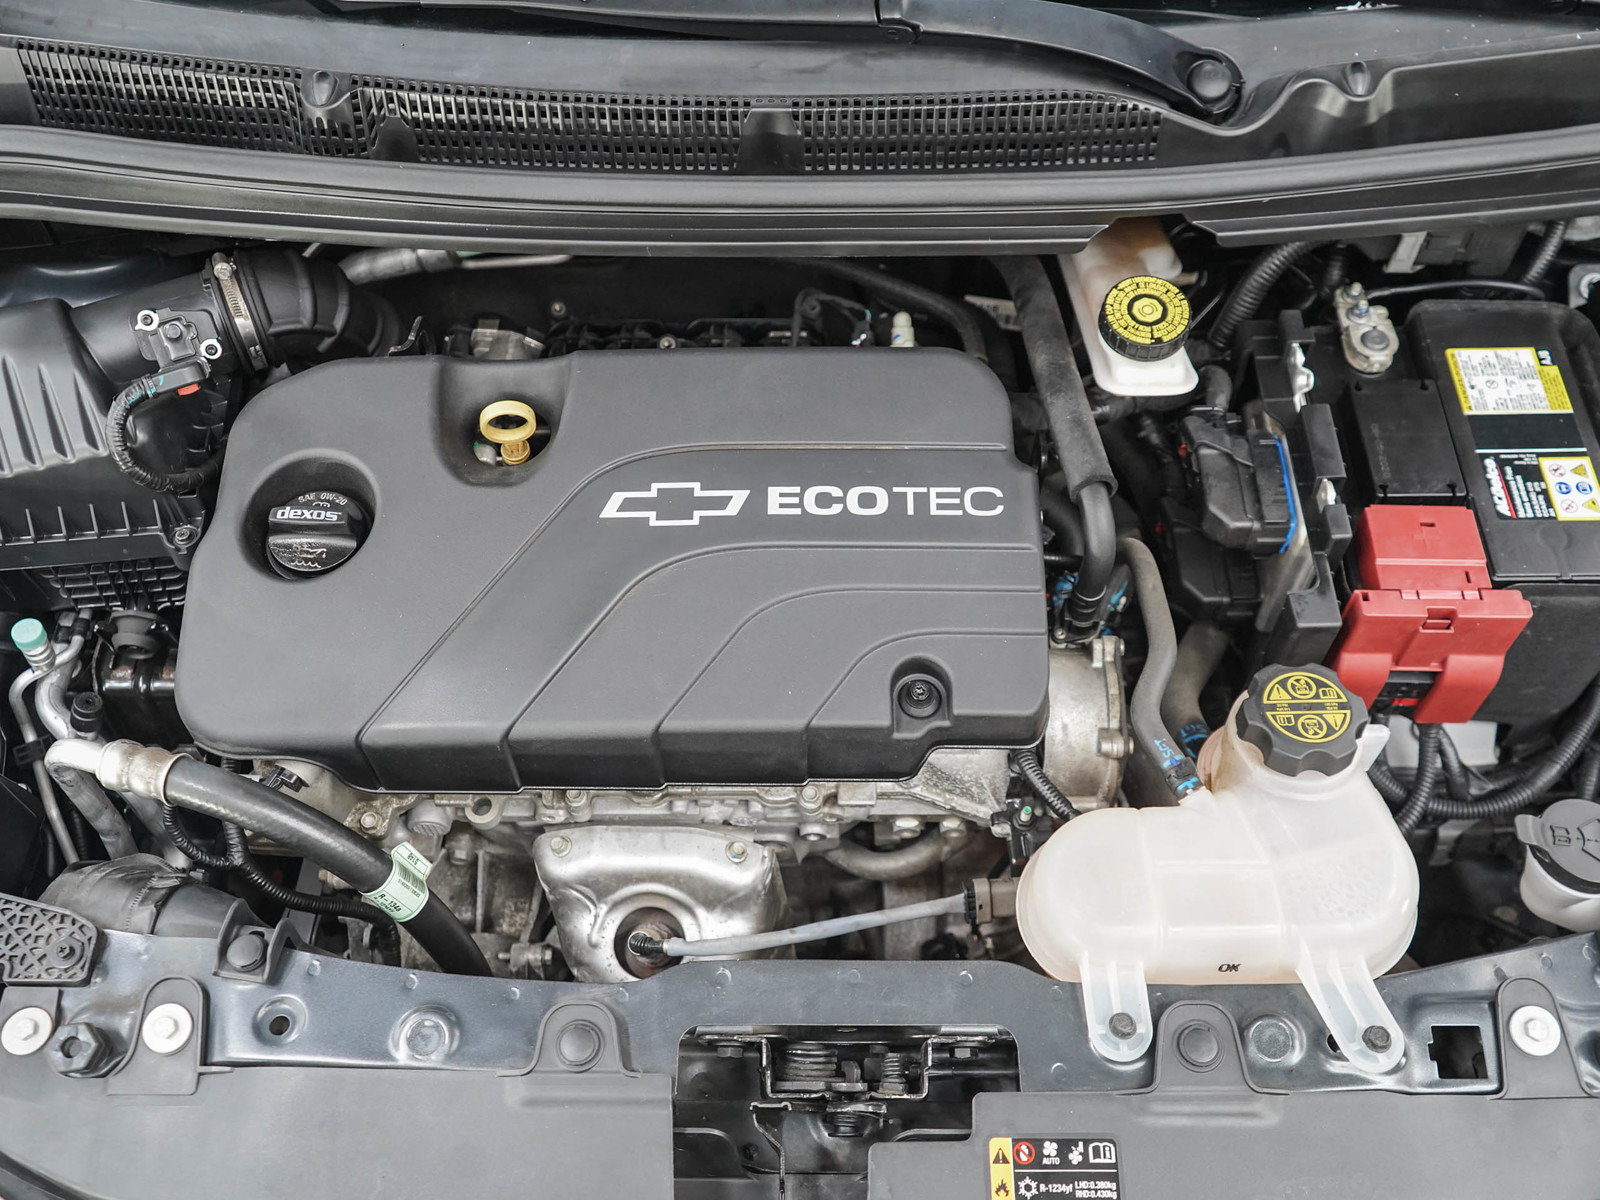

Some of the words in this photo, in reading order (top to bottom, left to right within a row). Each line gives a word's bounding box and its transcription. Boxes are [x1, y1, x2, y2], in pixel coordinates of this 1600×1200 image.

[298, 493, 316, 503] SAE
[320, 492, 348, 505] 0W-20
[767, 486, 1005, 516] ECOTEC
[276, 506, 339, 521] dexos
[1218, 963, 1242, 972] OK
[1042, 1157, 1060, 1165] AUTO
[1040, 1183, 1073, 1194] R-1234yf
